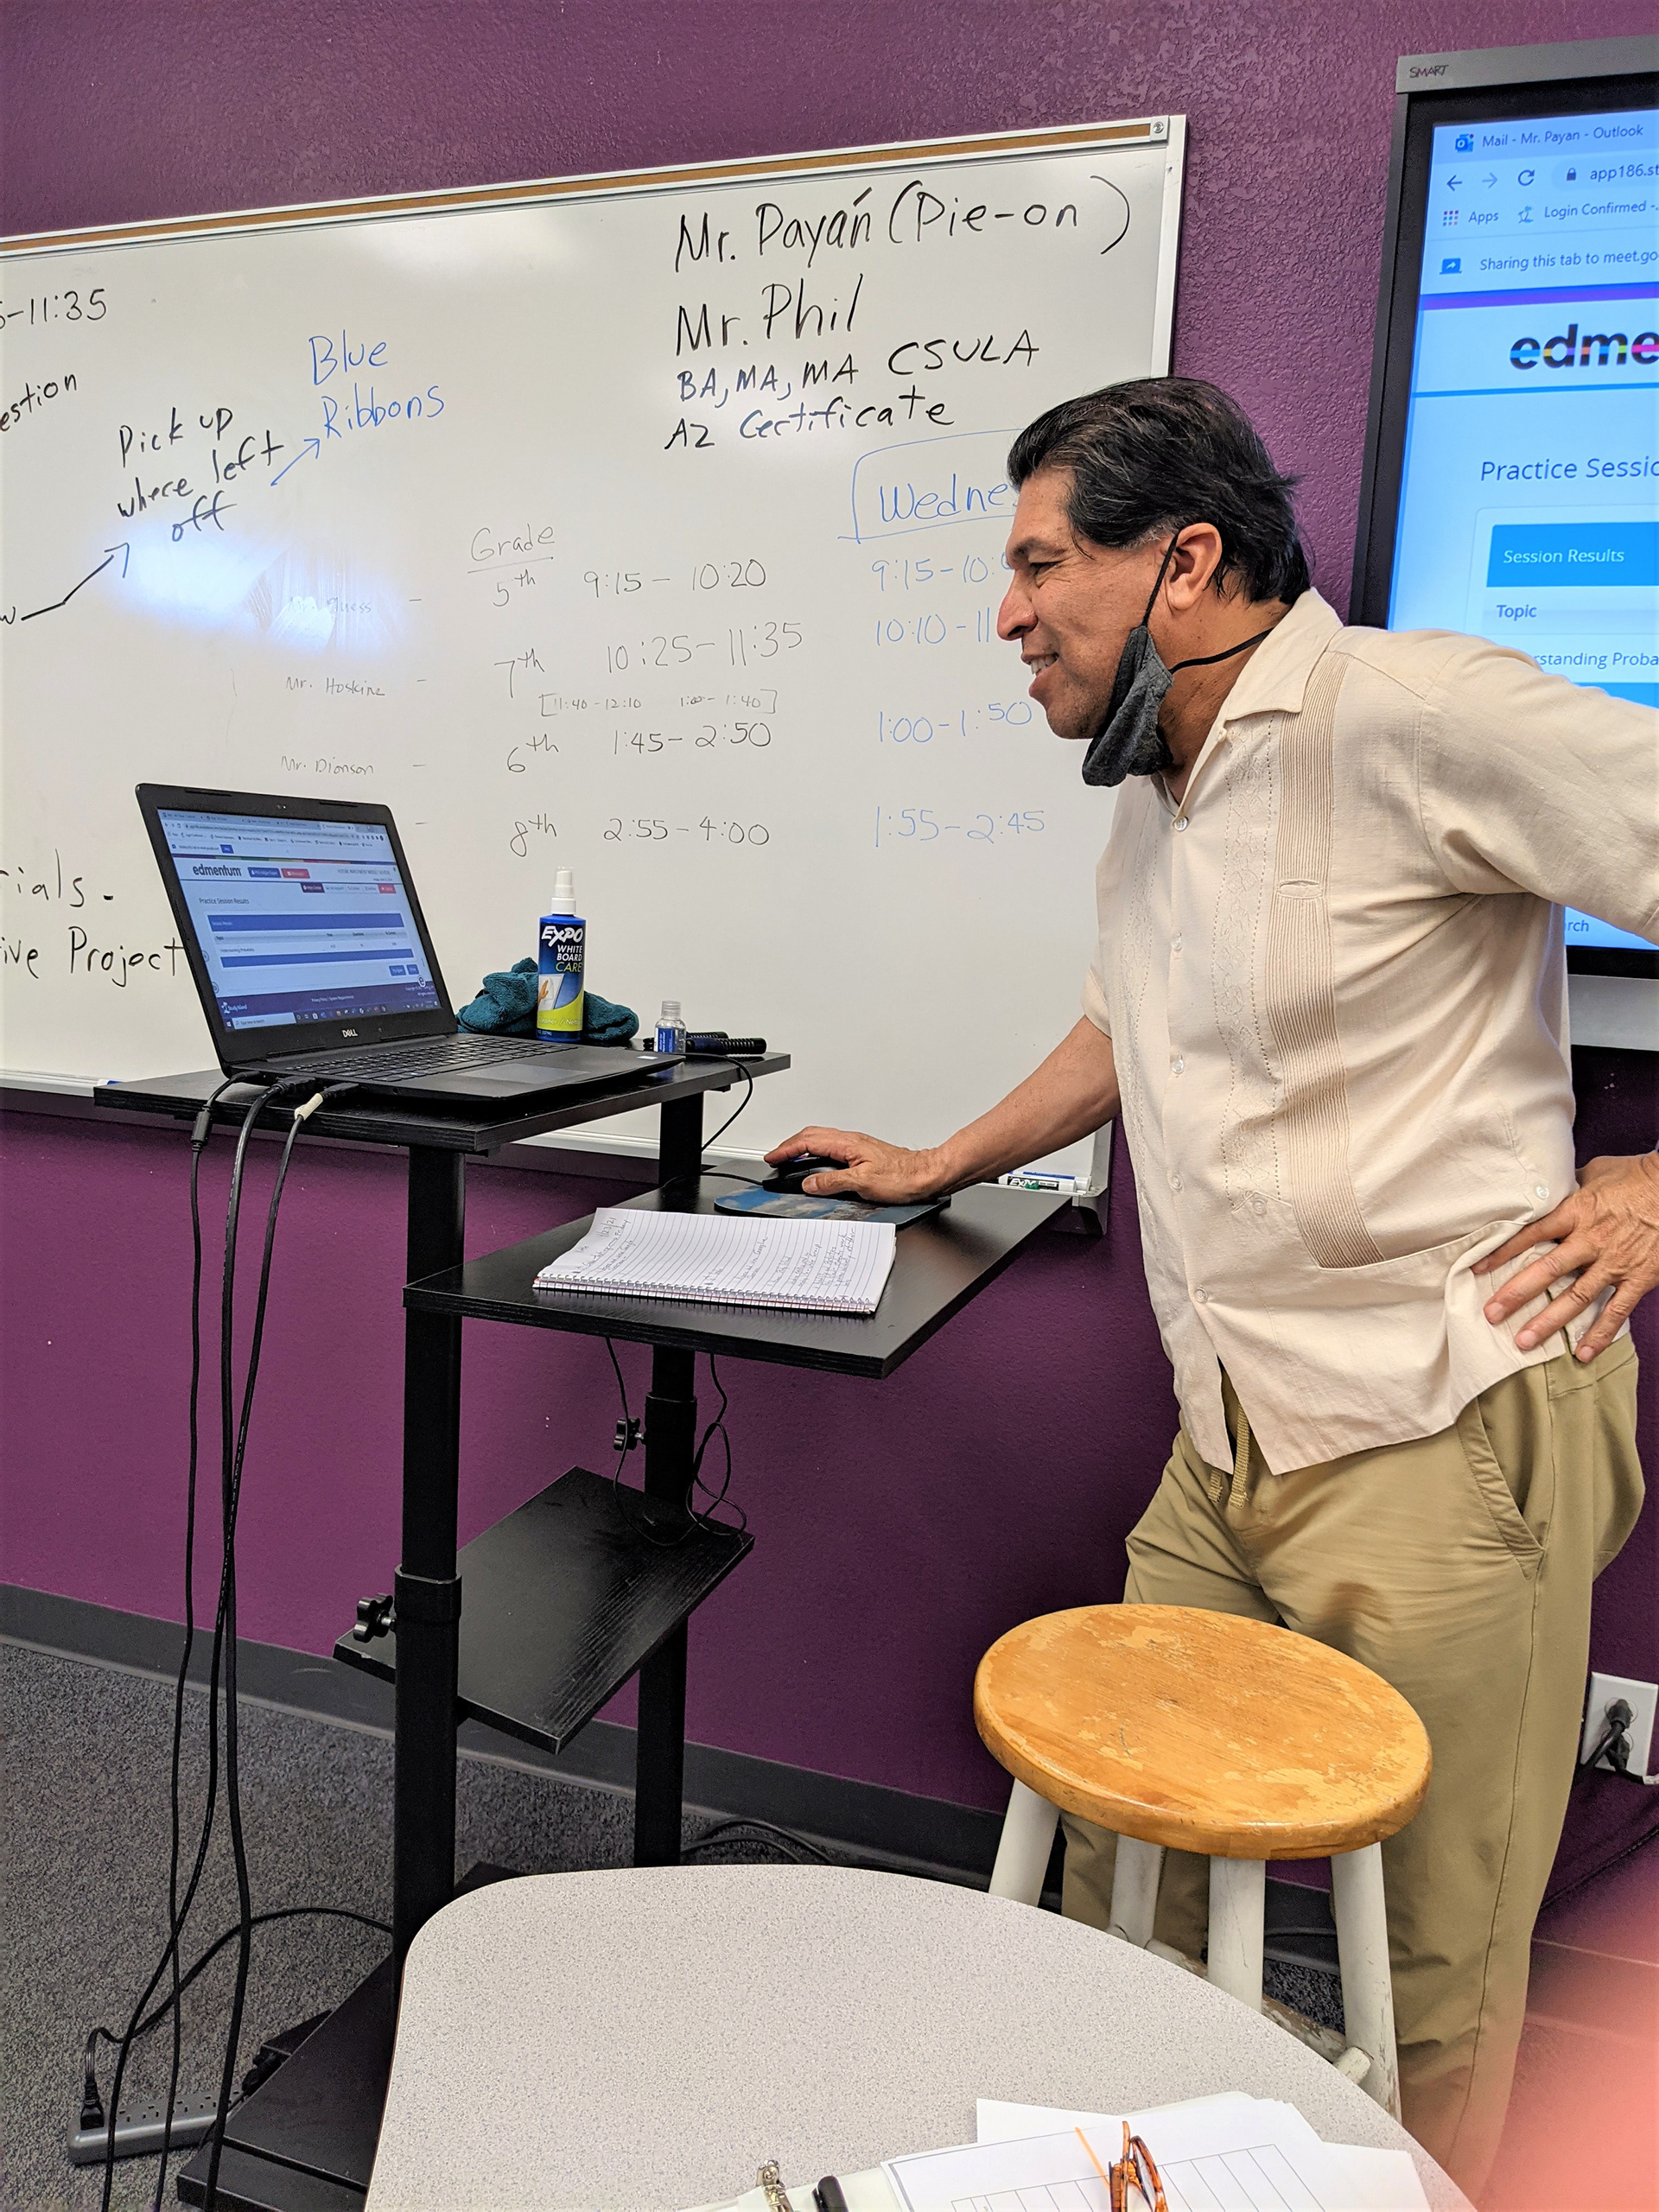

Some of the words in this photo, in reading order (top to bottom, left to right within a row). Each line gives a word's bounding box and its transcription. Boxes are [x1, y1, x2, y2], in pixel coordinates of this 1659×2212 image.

[1409, 64, 1449, 79] SMART
[1482, 131, 1508, 148] Mail
[1521, 131, 1541, 145] Mr.
[1544, 130, 1580, 146] Payan
[1593, 124, 1643, 139] Outlook
[1468, 211, 1499, 224] Apps
[1544, 204, 1578, 221] Login
[1581, 200, 1647, 216] Confirmed
[675, 213, 736, 272] Mr.
[1479, 256, 1529, 274] Sharing
[1533, 253, 1556, 270] this
[1560, 251, 1581, 267] tab
[1585, 251, 1599, 264] to
[677, 302, 749, 356] Mr.
[761, 273, 863, 339] Phil
[308, 330, 388, 385] Blue
[887, 329, 1040, 377] CSULA
[321, 383, 445, 438] Ribbons
[739, 385, 955, 439] Certificate
[119, 408, 184, 467] Pick
[200, 408, 233, 441] up
[118, 478, 194, 518] where
[213, 429, 284, 483] left
[1480, 460, 1578, 481] Practice
[880, 474, 1019, 523] Wedne
[172, 491, 238, 542] off
[470, 524, 556, 562] Grade
[1503, 550, 1562, 563] Session
[1567, 548, 1624, 563] Results
[1496, 604, 1537, 621] Topic
[286, 677, 312, 690] Mr.
[282, 755, 306, 771] Mr.
[193, 863, 242, 877] edmentum
[542, 925, 583, 947] EXPO
[68, 925, 185, 987] Project
[557, 944, 582, 953] WHITE
[556, 962, 582, 972] CARE
[342, 1028, 358, 1037] DELL
